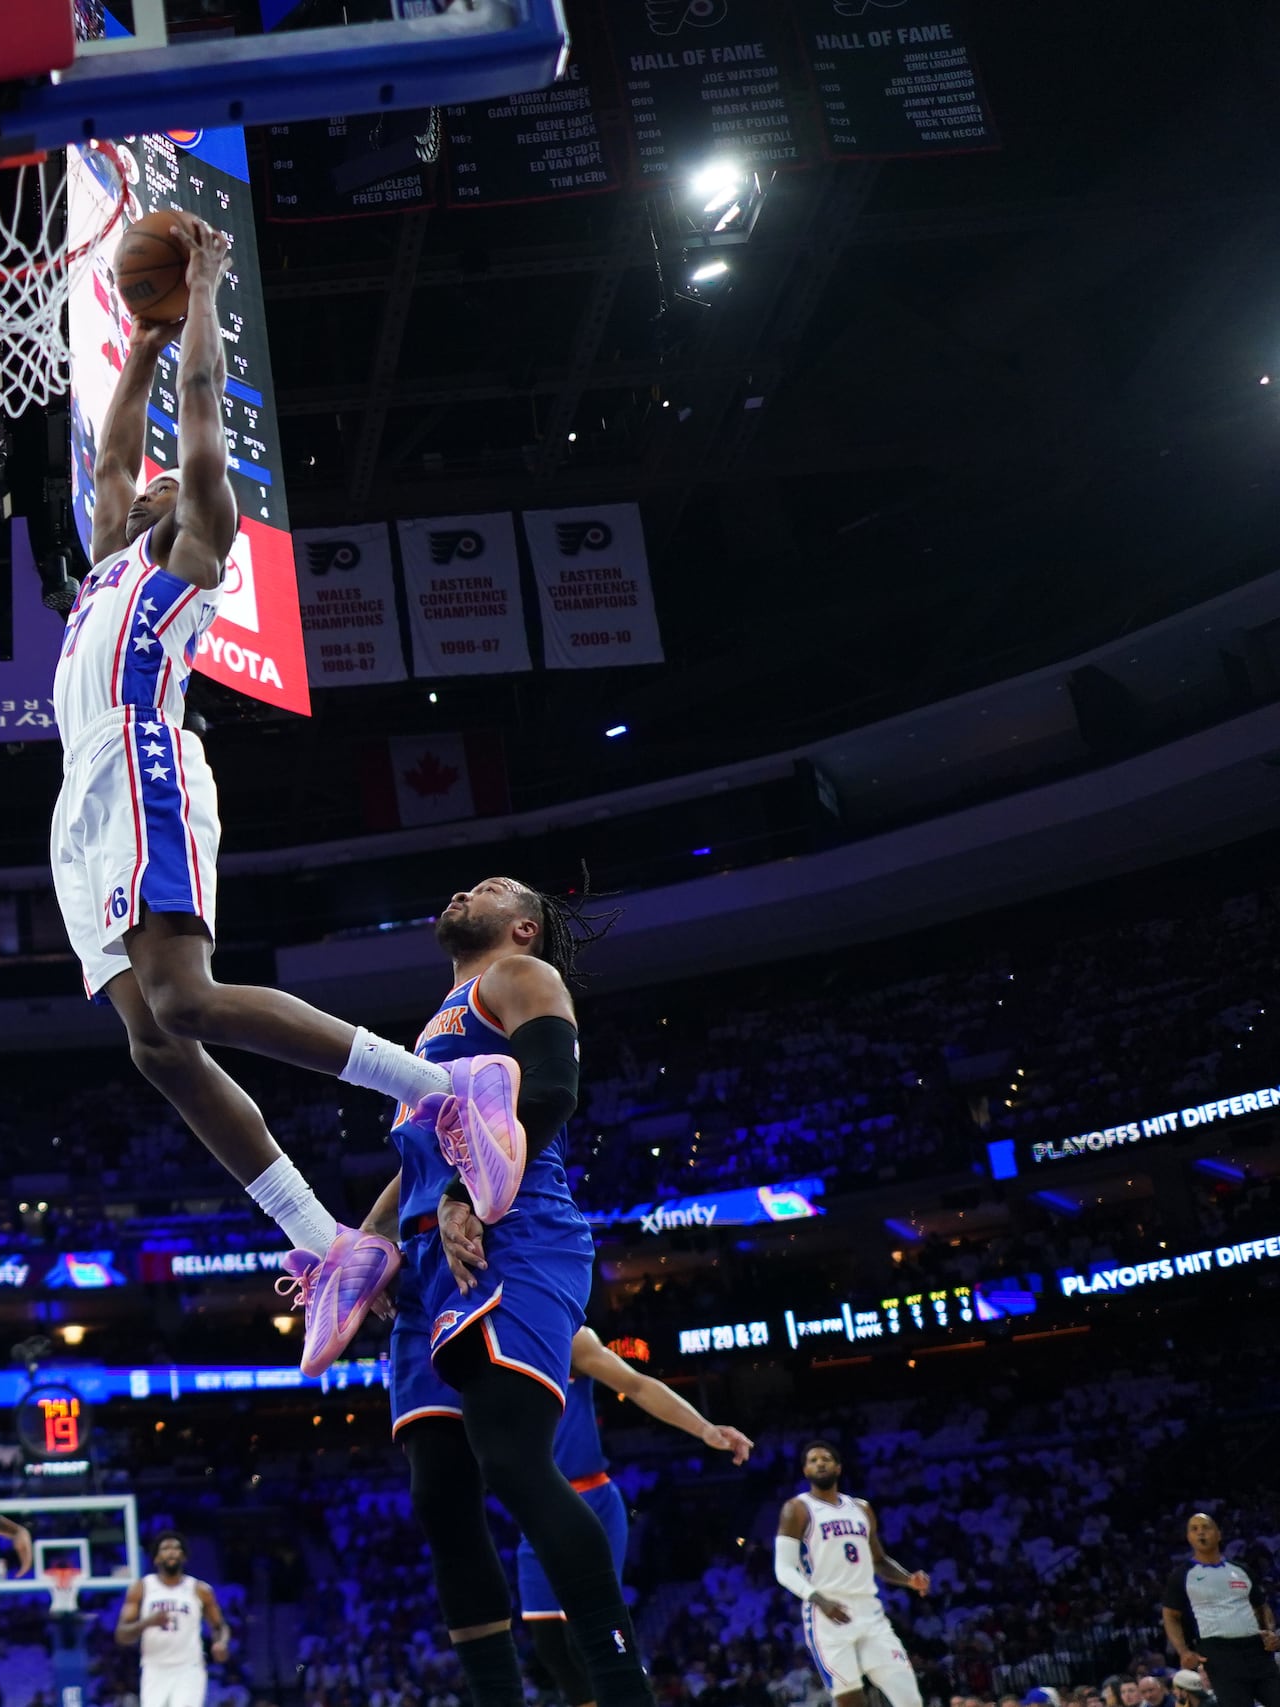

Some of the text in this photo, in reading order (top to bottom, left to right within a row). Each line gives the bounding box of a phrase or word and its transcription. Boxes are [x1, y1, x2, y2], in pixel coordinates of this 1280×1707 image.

[816, 24, 953, 50] HALL OF FAME
[629, 43, 767, 71] HALL OF FAME
[702, 66, 778, 84] JOE WATSON
[509, 92, 548, 105] BARRY
[701, 88, 740, 100] BRIAN
[488, 106, 518, 119] GARY
[712, 104, 750, 116] MARK
[517, 131, 560, 145] REGGIE
[543, 148, 564, 160] JOE
[529, 158, 572, 172] ED VAN
[549, 176, 573, 189] TIM
[353, 189, 382, 205] FRED
[431, 576, 493, 592] EASTERN
[560, 568, 623, 584] EASTERN
[316, 588, 362, 602] WALES
[548, 580, 638, 597] CONFERENCE
[419, 590, 508, 607] CONFERENCE
[554, 594, 638, 612] CHAMPIONS
[424, 604, 507, 620] CHAMPIONS
[570, 631, 632, 648] 2009-10
[197, 631, 283, 689] OYOTA
[424, 1005, 469, 1041] ORK
[1032, 1086, 1280, 1162] PLAYOFFS HIT DIFFEREN
[640, 1202, 718, 1235] xfinity
[172, 1253, 257, 1276] RELIABLE
[1061, 1235, 1280, 1298] PLAYOFFS HIT DIFFE
[711, 1325, 734, 1350] 20
[45, 1416, 79, 1453] 19
[820, 1520, 868, 1540] PHILA
[844, 1543, 859, 1564] 8
